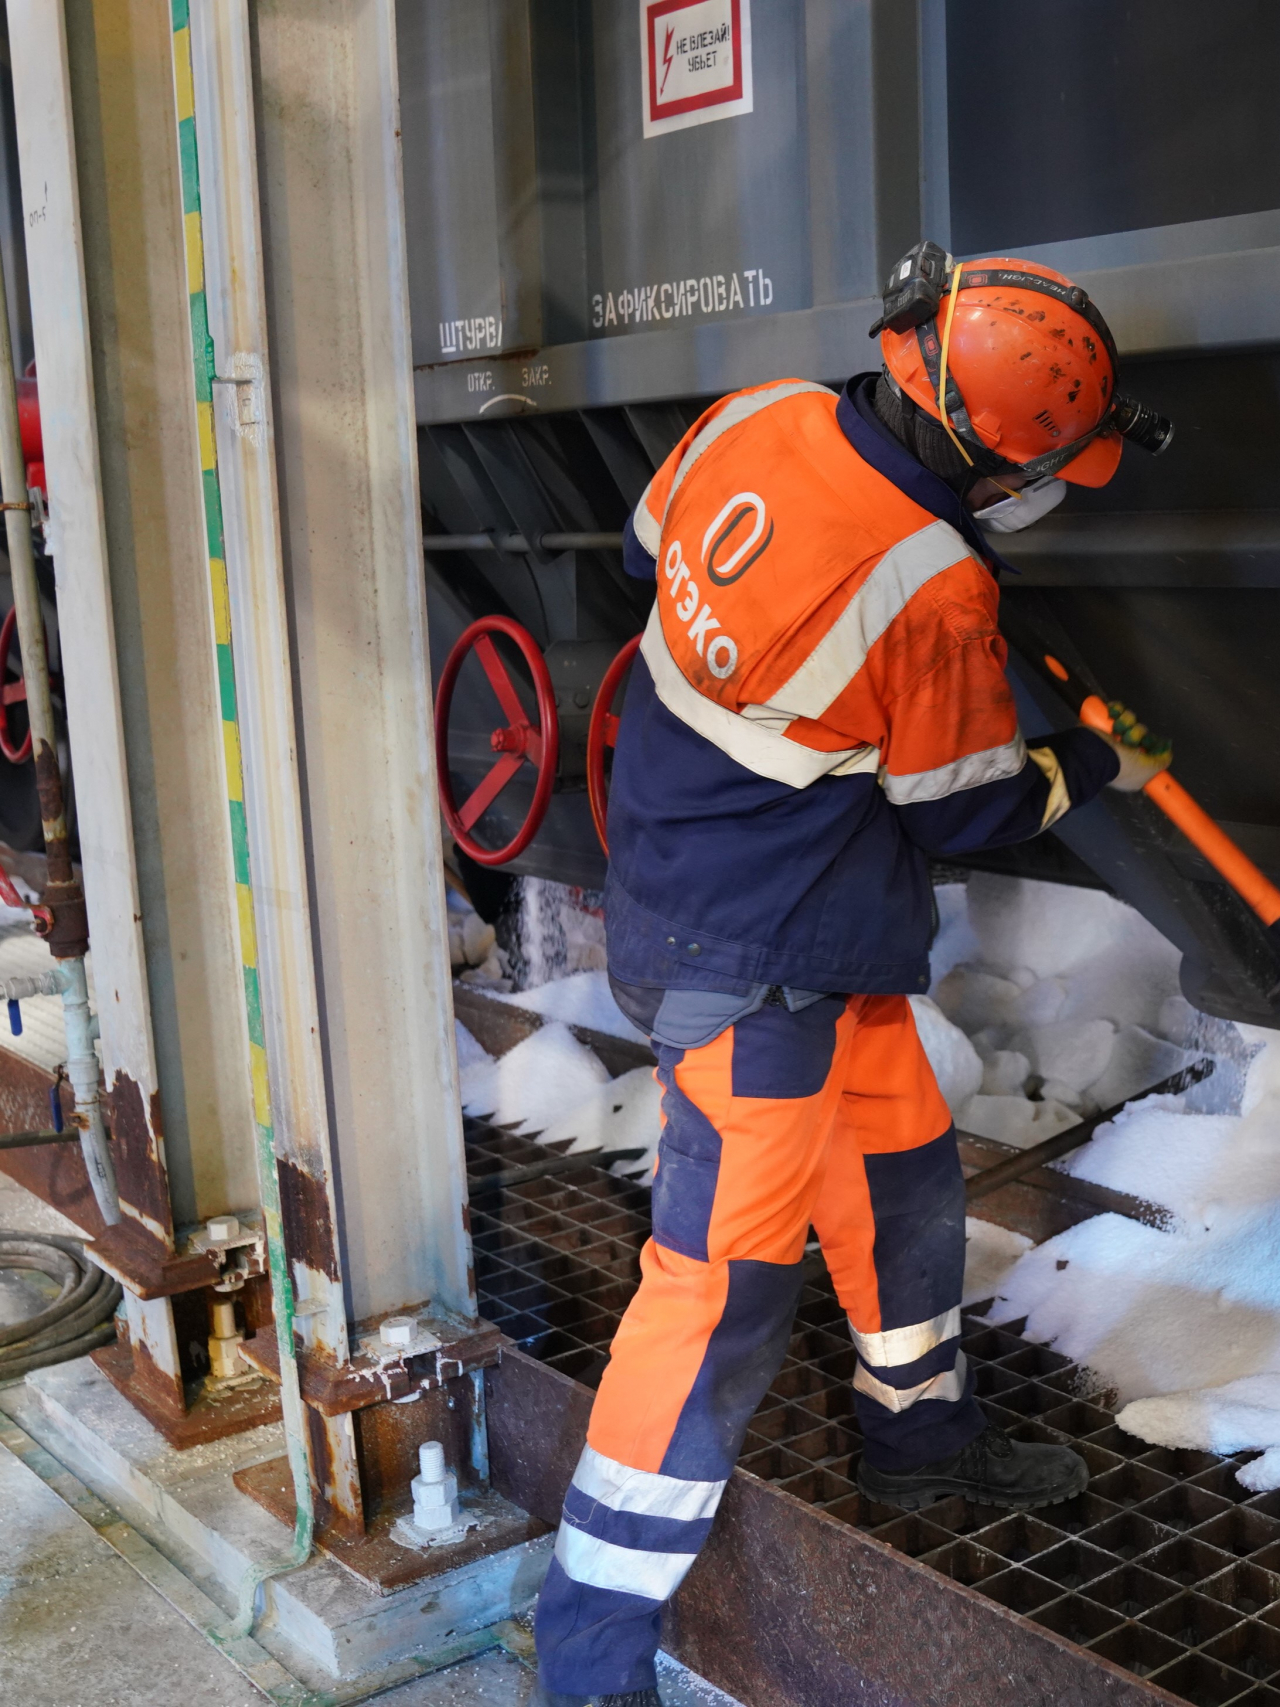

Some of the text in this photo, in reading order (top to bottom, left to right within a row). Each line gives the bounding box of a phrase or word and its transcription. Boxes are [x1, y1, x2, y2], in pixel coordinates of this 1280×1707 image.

[676, 23, 730, 55] НЕ ВЛЕЗАЙ!
[688, 50, 717, 73] УБЬЕТ
[439, 268, 774, 354] ШТУРВ ЗАФИКСИРОВАТЬ
[467, 365, 552, 393] ОТКР. ЗАКР.
[665, 540, 738, 680] ОТЭКО
